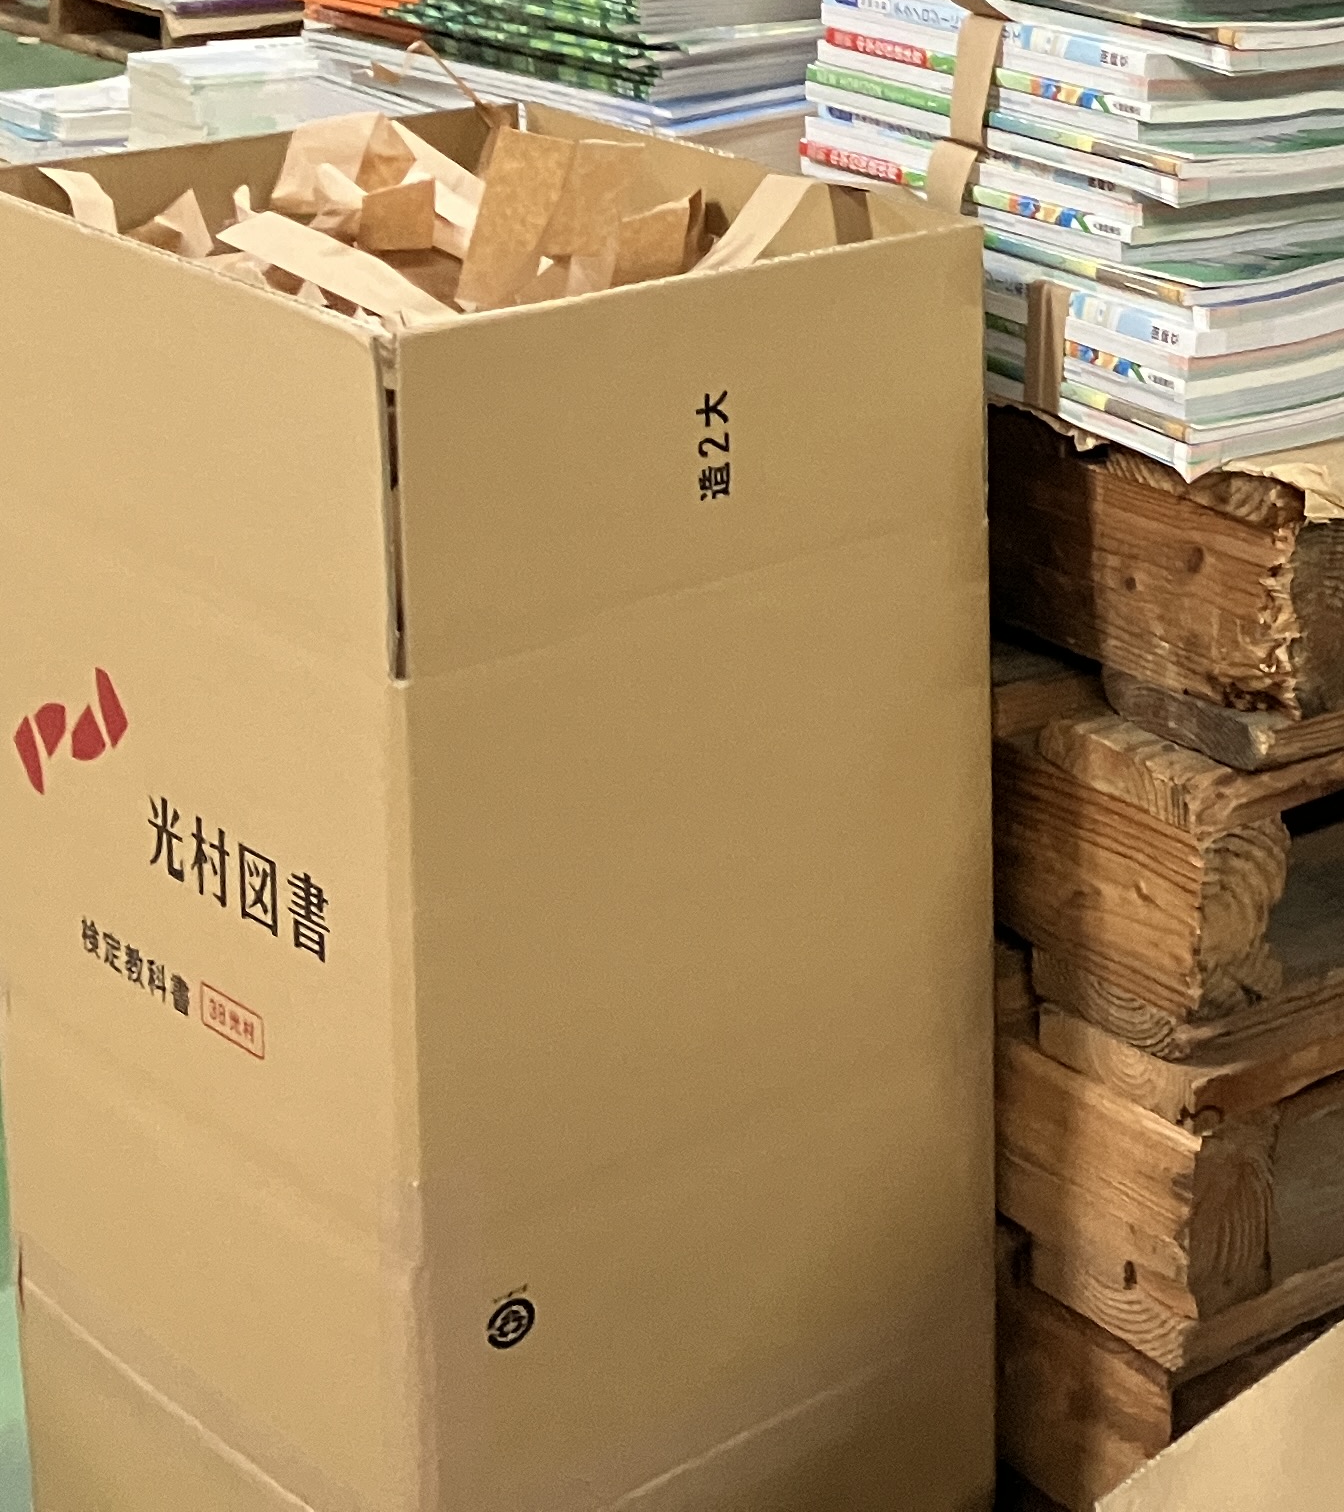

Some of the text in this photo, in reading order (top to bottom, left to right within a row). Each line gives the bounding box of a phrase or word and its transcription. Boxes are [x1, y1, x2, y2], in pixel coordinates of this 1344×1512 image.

[147, 794, 331, 964] 光村図書
[81, 915, 191, 1017] 検定教科書
